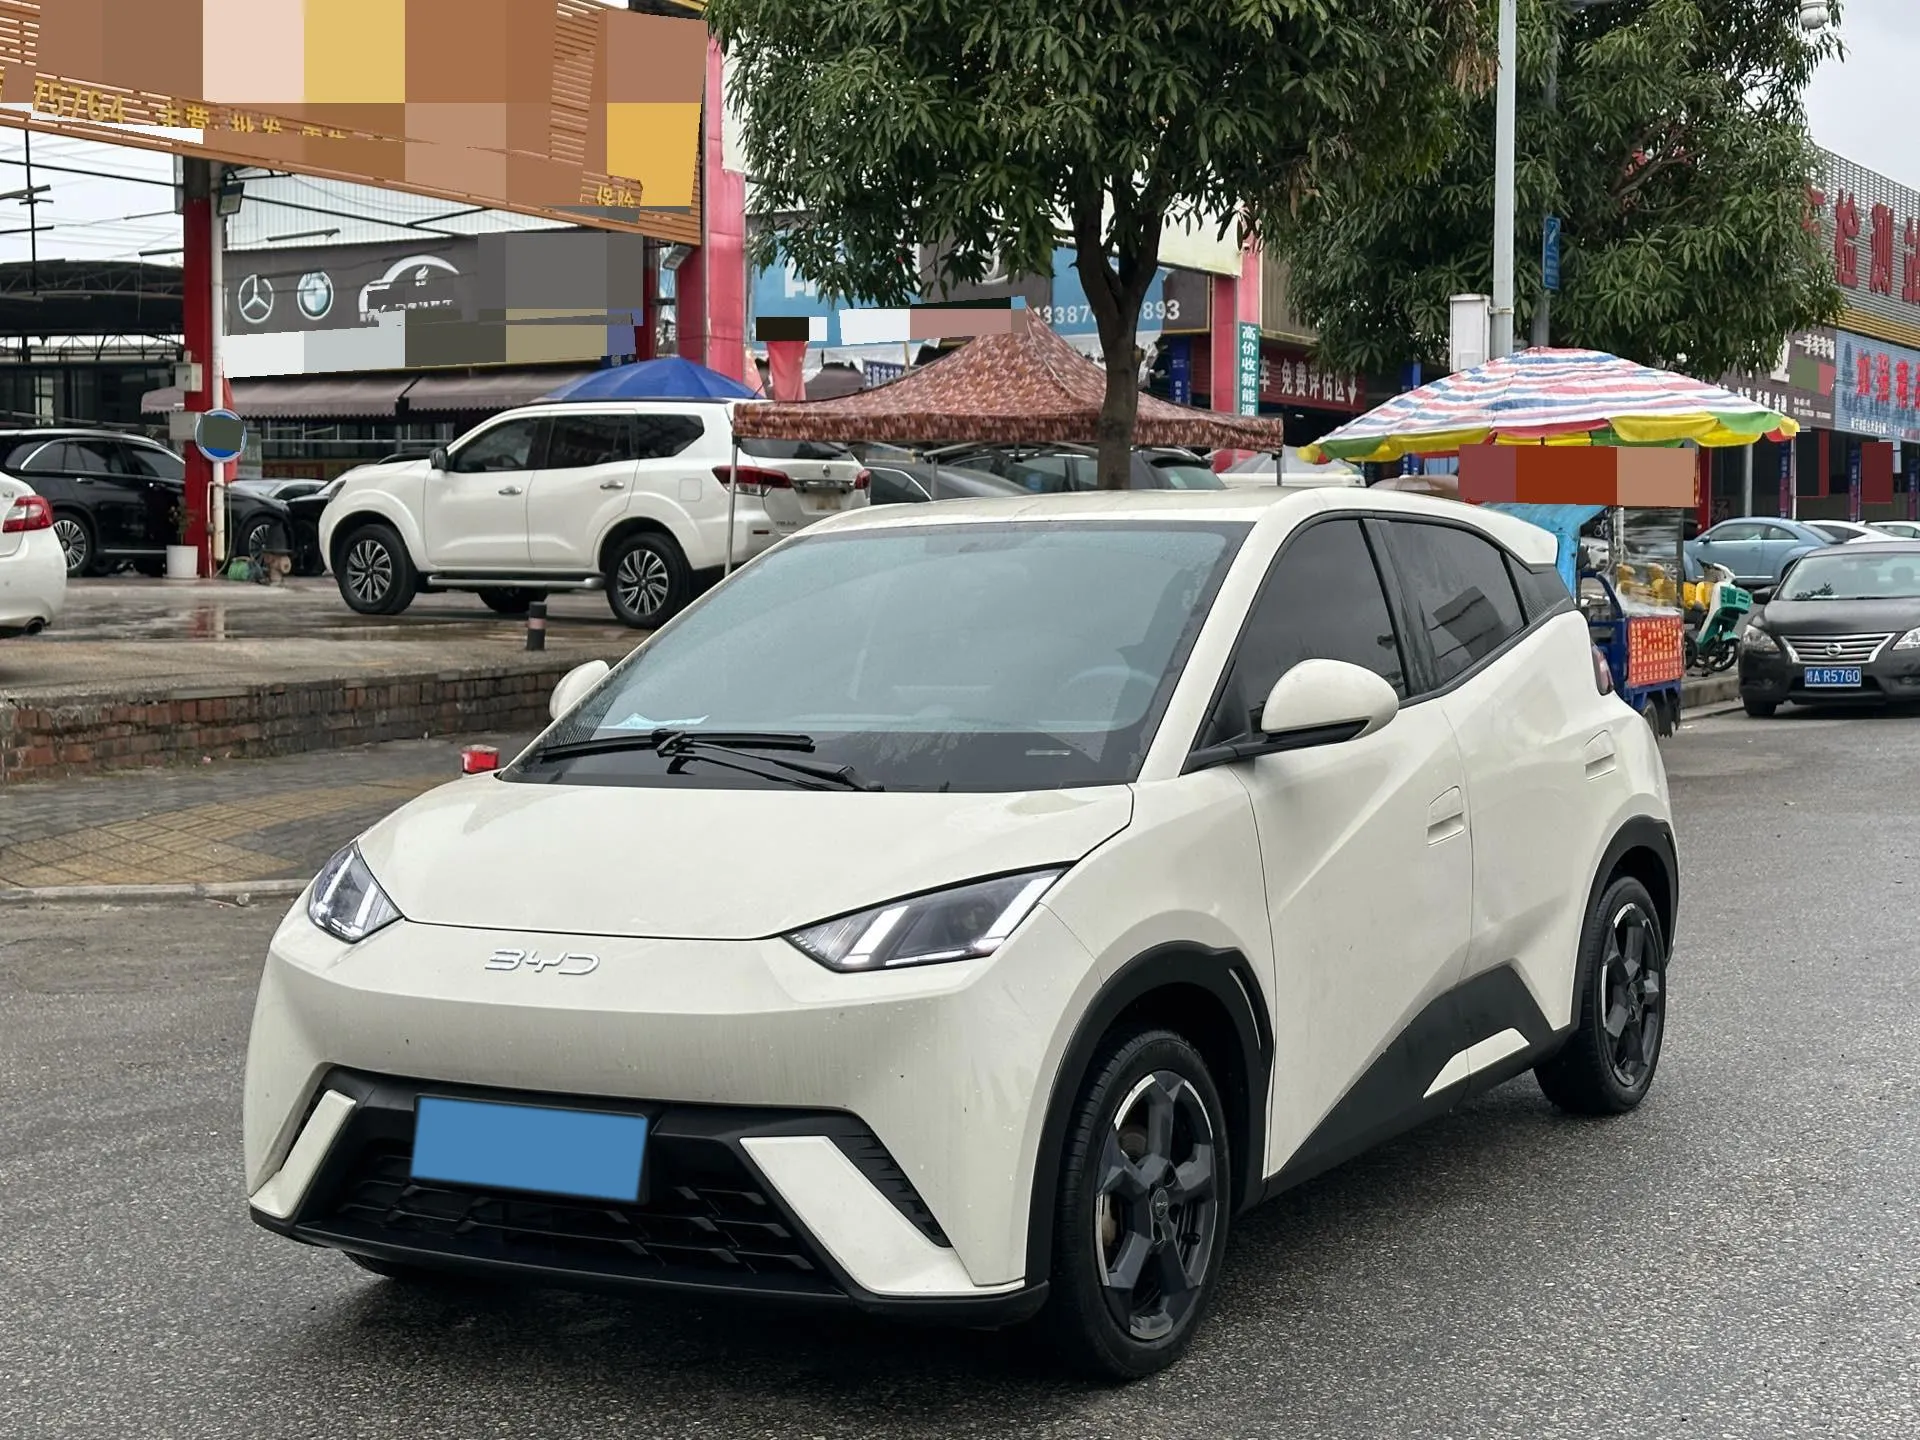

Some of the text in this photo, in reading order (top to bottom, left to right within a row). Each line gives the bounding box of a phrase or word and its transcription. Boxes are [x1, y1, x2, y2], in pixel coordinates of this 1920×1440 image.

[1241, 325, 1256, 416] 高价收新能源
[1281, 358, 1345, 402] 免费评估区
[484, 948, 600, 975] BYD
